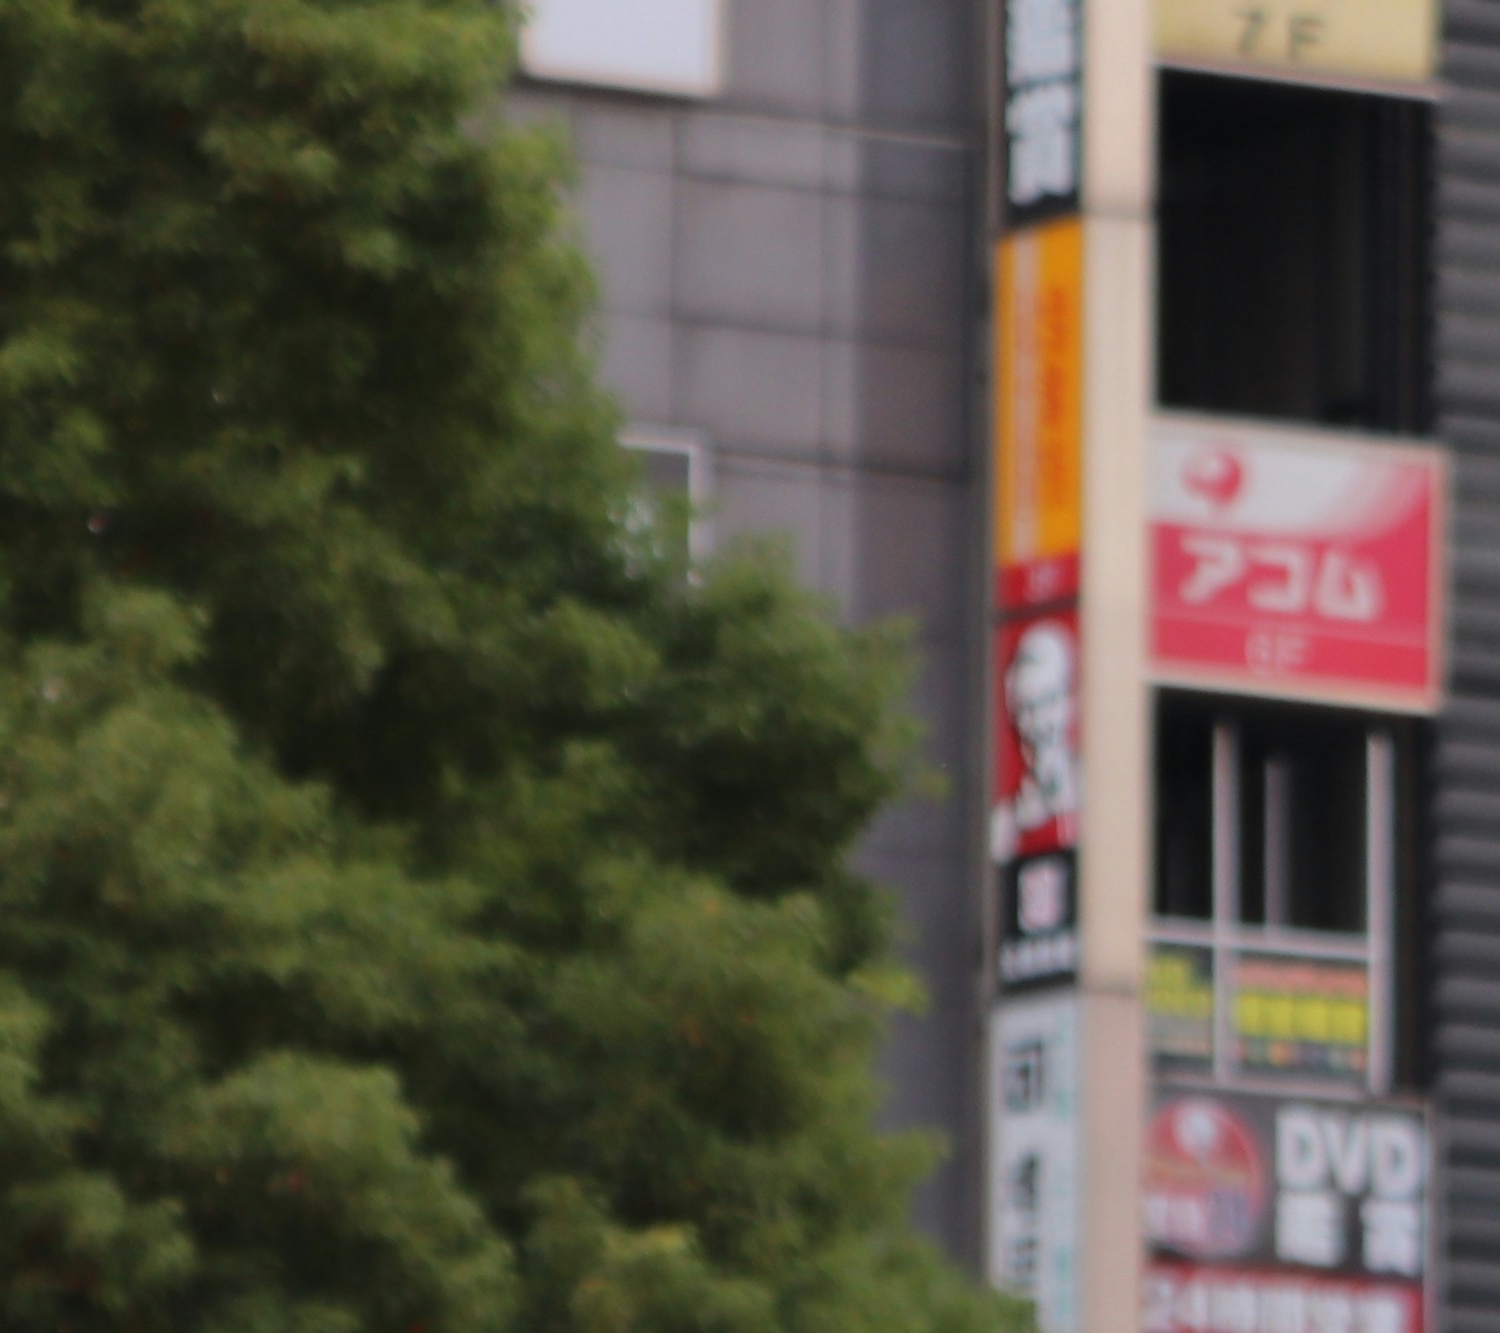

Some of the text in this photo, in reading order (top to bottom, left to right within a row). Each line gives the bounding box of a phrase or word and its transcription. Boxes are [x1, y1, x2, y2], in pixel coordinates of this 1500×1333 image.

[1178, 533, 1384, 623] アコム
[1276, 1106, 1428, 1198] DVD
